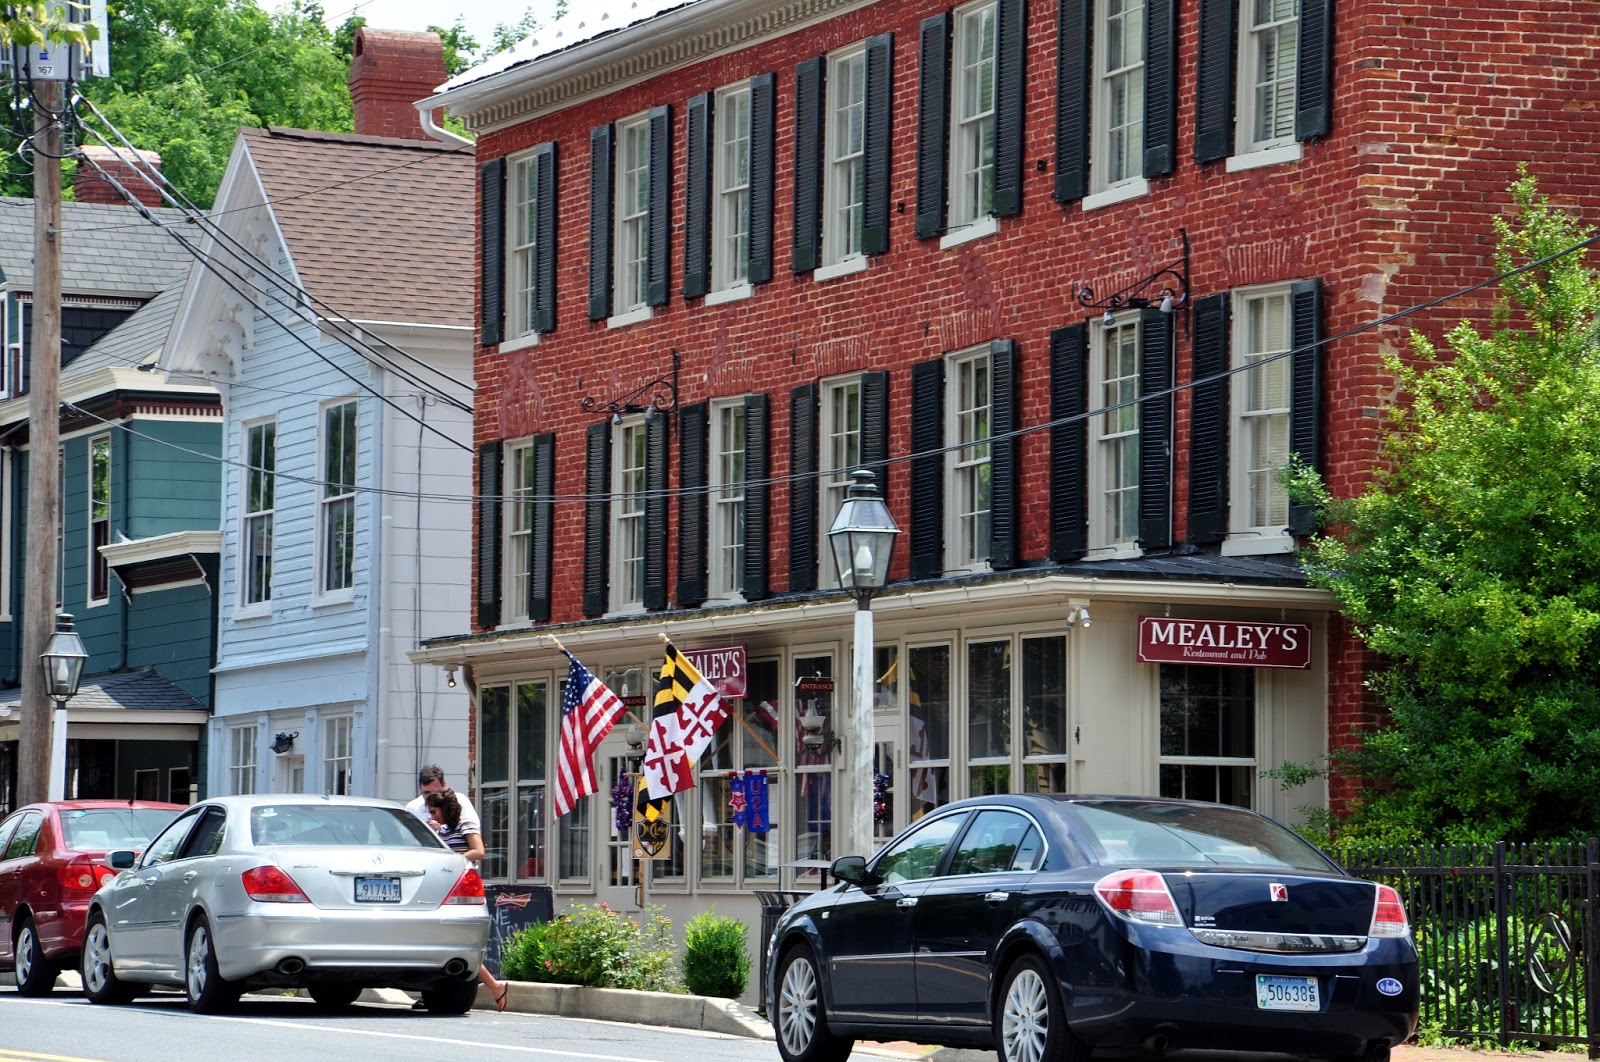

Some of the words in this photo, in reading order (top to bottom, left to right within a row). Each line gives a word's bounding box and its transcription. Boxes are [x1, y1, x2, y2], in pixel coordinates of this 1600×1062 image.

[38, 66, 53, 74] 167
[1150, 621, 1298, 650] MEALEY'S
[1183, 646, 1229, 660] Restaurant
[1230, 650, 1247, 660] and
[1249, 649, 1267, 661] Pub
[686, 651, 741, 679] ALEY'S
[363, 884, 392, 896] 91741
[1267, 984, 1308, 1002] 50638
